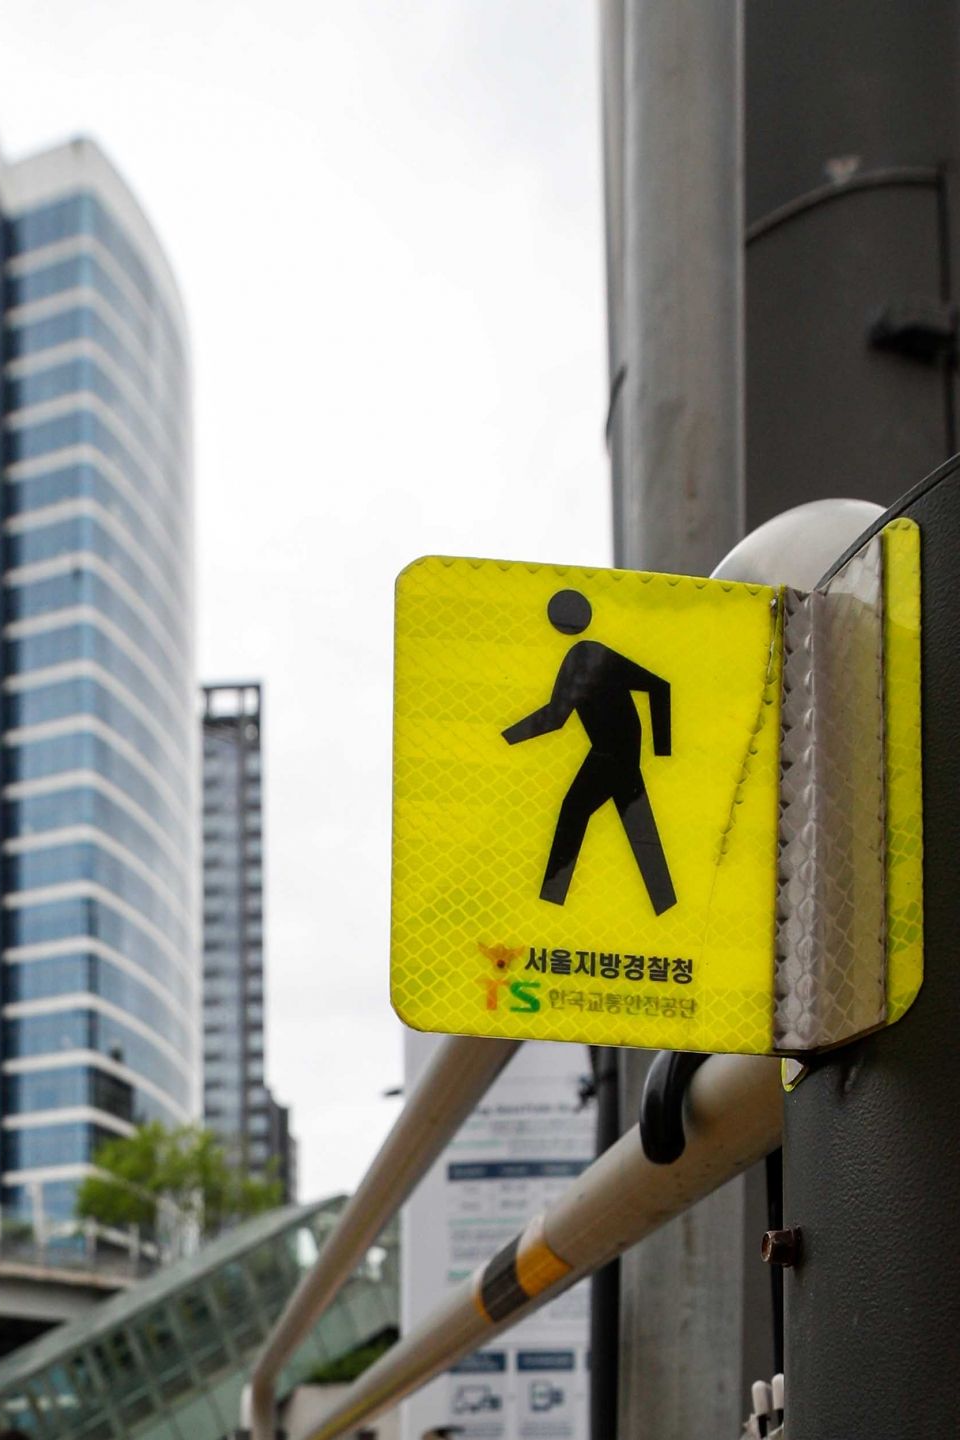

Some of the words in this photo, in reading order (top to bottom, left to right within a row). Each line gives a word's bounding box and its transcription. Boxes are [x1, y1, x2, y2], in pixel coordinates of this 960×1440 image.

[524, 947, 694, 984] 서울지방경찰청
[478, 977, 541, 1013] TS
[548, 987, 698, 1019] 한국교통안전공단
